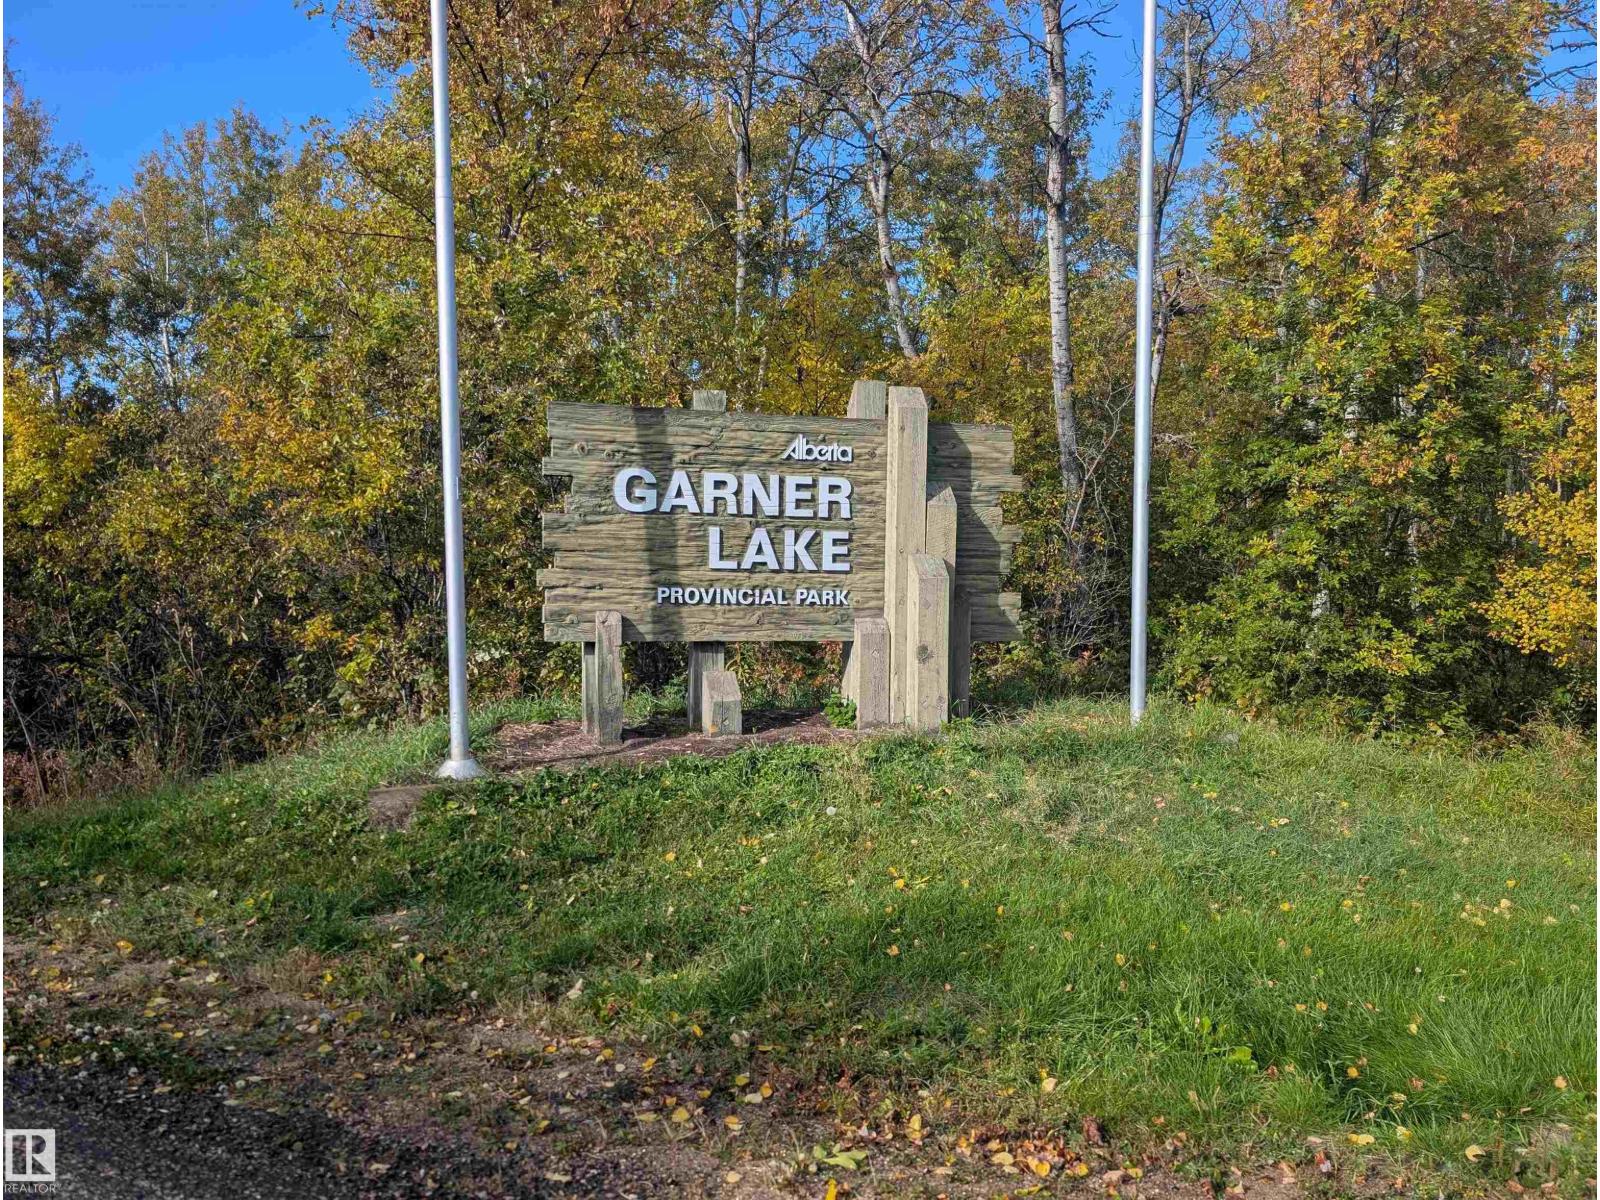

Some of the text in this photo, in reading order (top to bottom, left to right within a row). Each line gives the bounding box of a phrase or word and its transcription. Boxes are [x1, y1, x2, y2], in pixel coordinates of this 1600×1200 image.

[782, 434, 853, 463] Alberta
[613, 467, 852, 519] GARNER
[708, 527, 851, 572] LAKE
[657, 586, 849, 607] PROVINCIAL PARK
